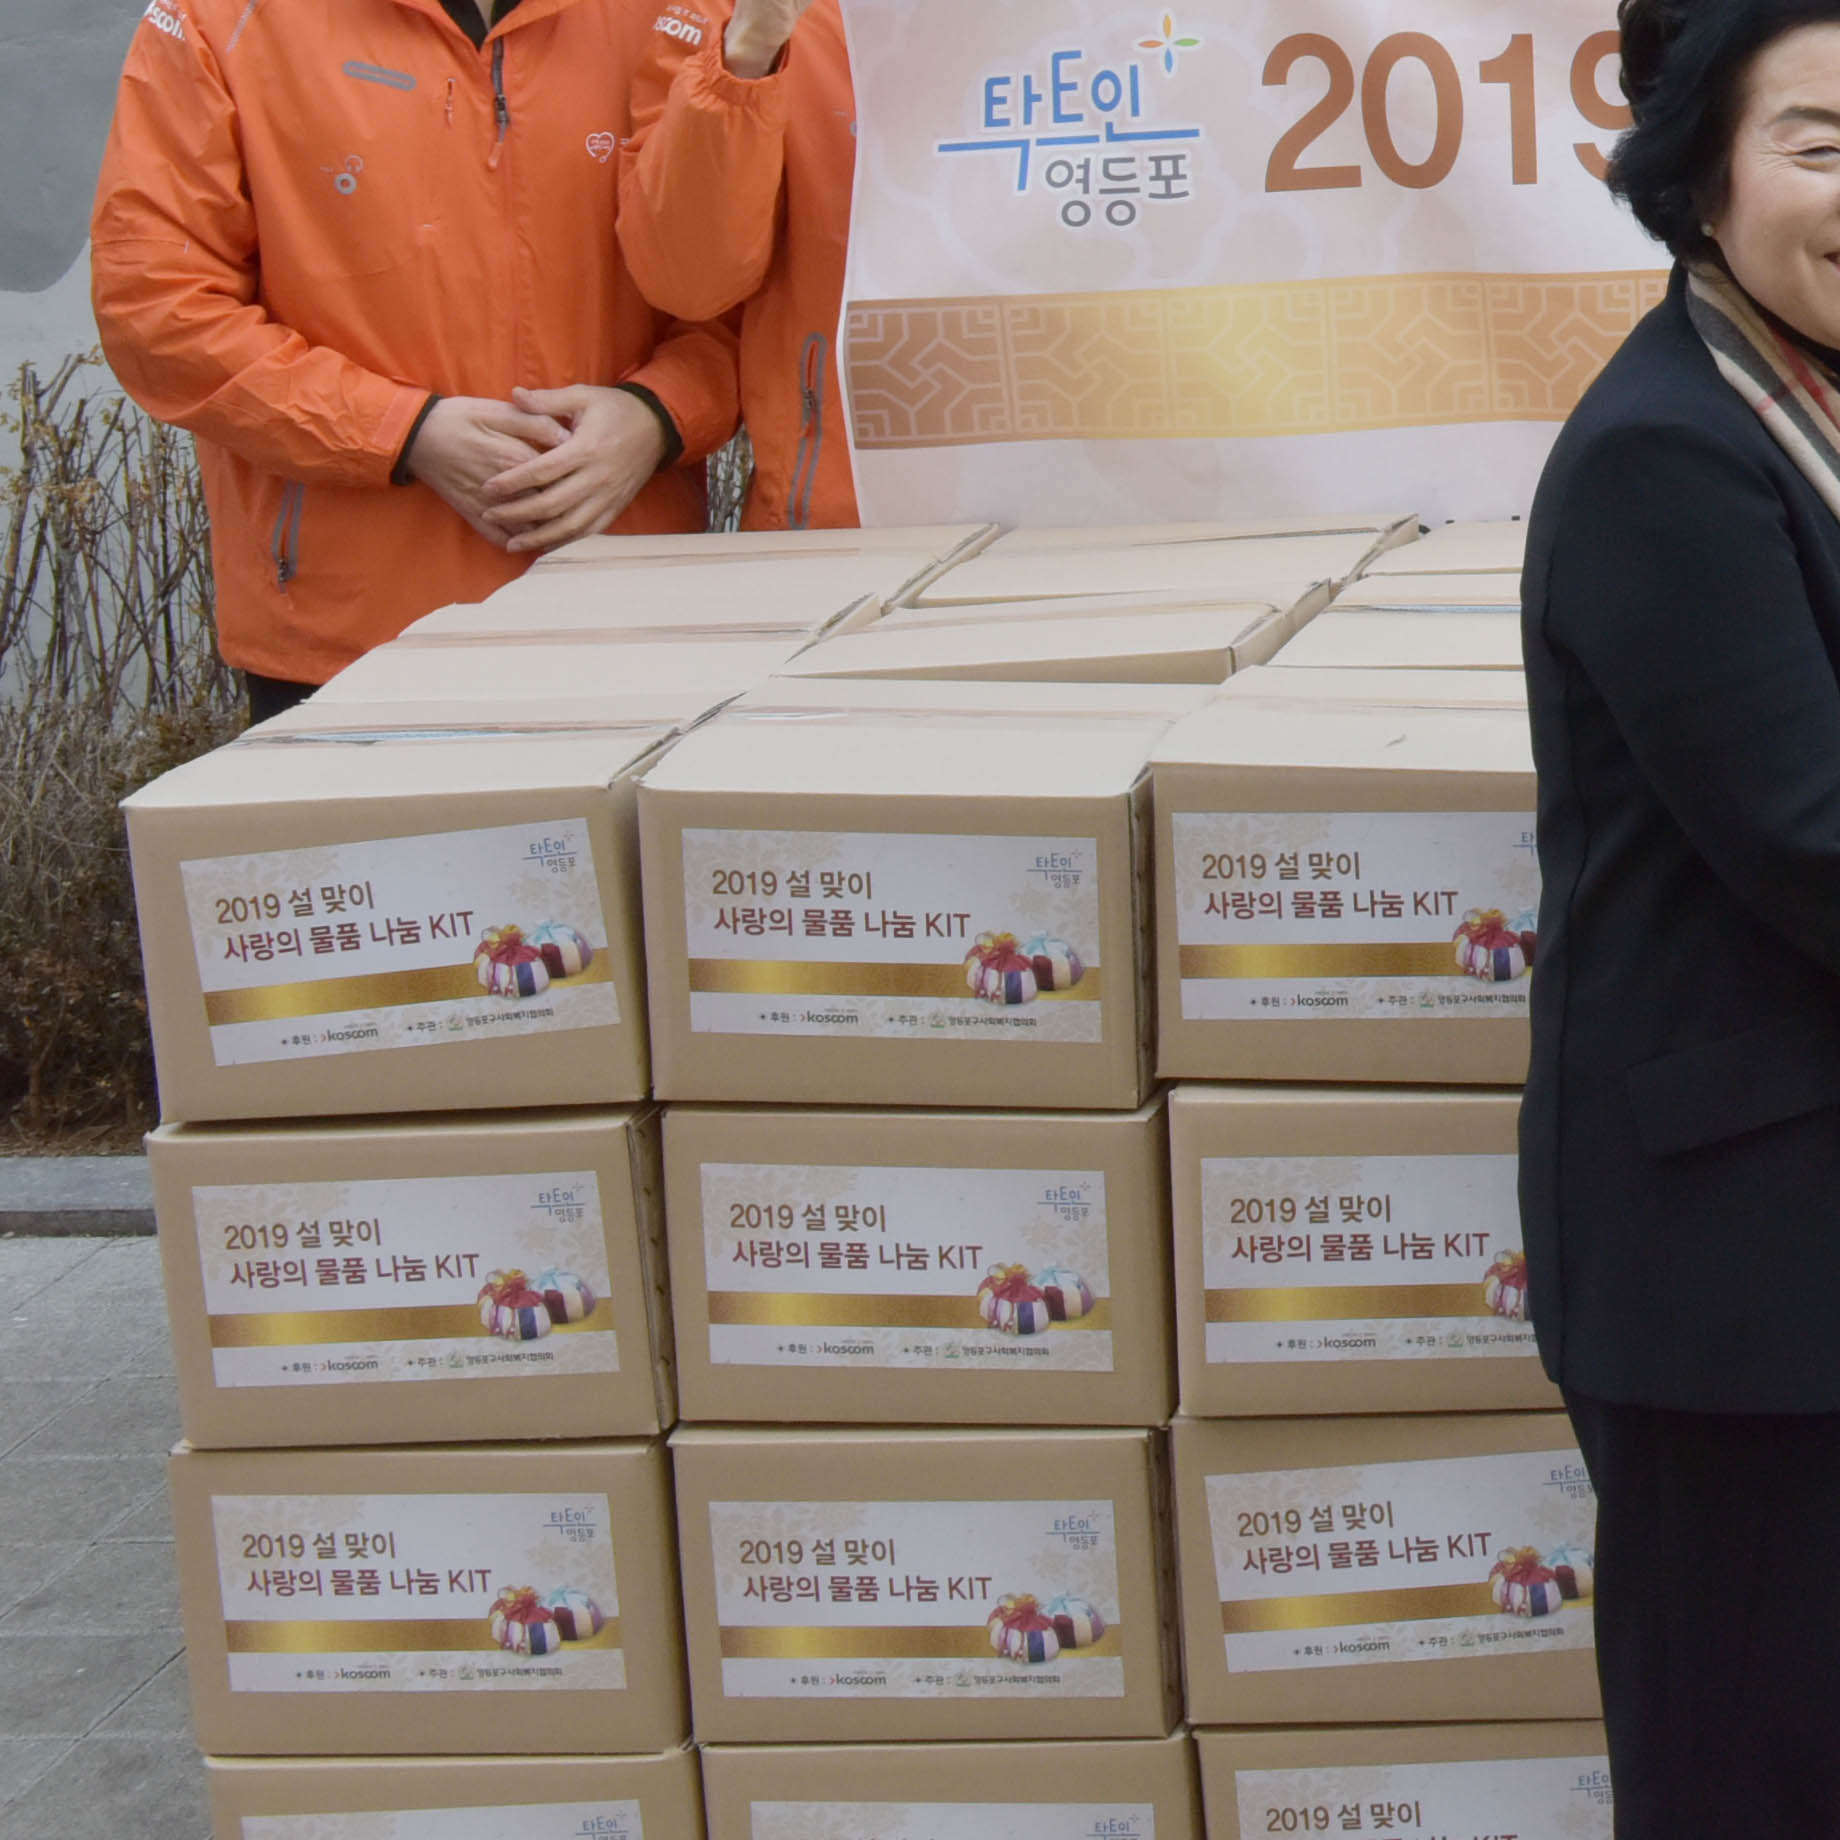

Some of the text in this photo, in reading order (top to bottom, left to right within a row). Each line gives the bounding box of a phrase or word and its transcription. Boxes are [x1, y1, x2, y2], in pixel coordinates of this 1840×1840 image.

[1045, 154, 1191, 228] 영등포
[1201, 851, 1360, 880] 2019 설 맞이
[712, 869, 872, 900] 2019 설 맞이
[215, 881, 374, 925] 2019 설 맞이
[1204, 890, 1459, 920] 사랑의 물품 나눔 KIT
[224, 910, 474, 963] 사랑의 물품 나눔 KIT
[714, 906, 971, 939] 사랑의 물품 나눔 KIT
[729, 1203, 886, 1233] 2019 설 맞이
[224, 1218, 381, 1251] 2019 설 맞이
[230, 1253, 480, 1289] 사랑의 물품 나눔 KIT
[732, 1239, 983, 1271] 사랑의 물품 나눔 KIT
[241, 1531, 396, 1559] 2019 설 맞이
[246, 1568, 492, 1597] 사랑의 물품 나눔 KIT
